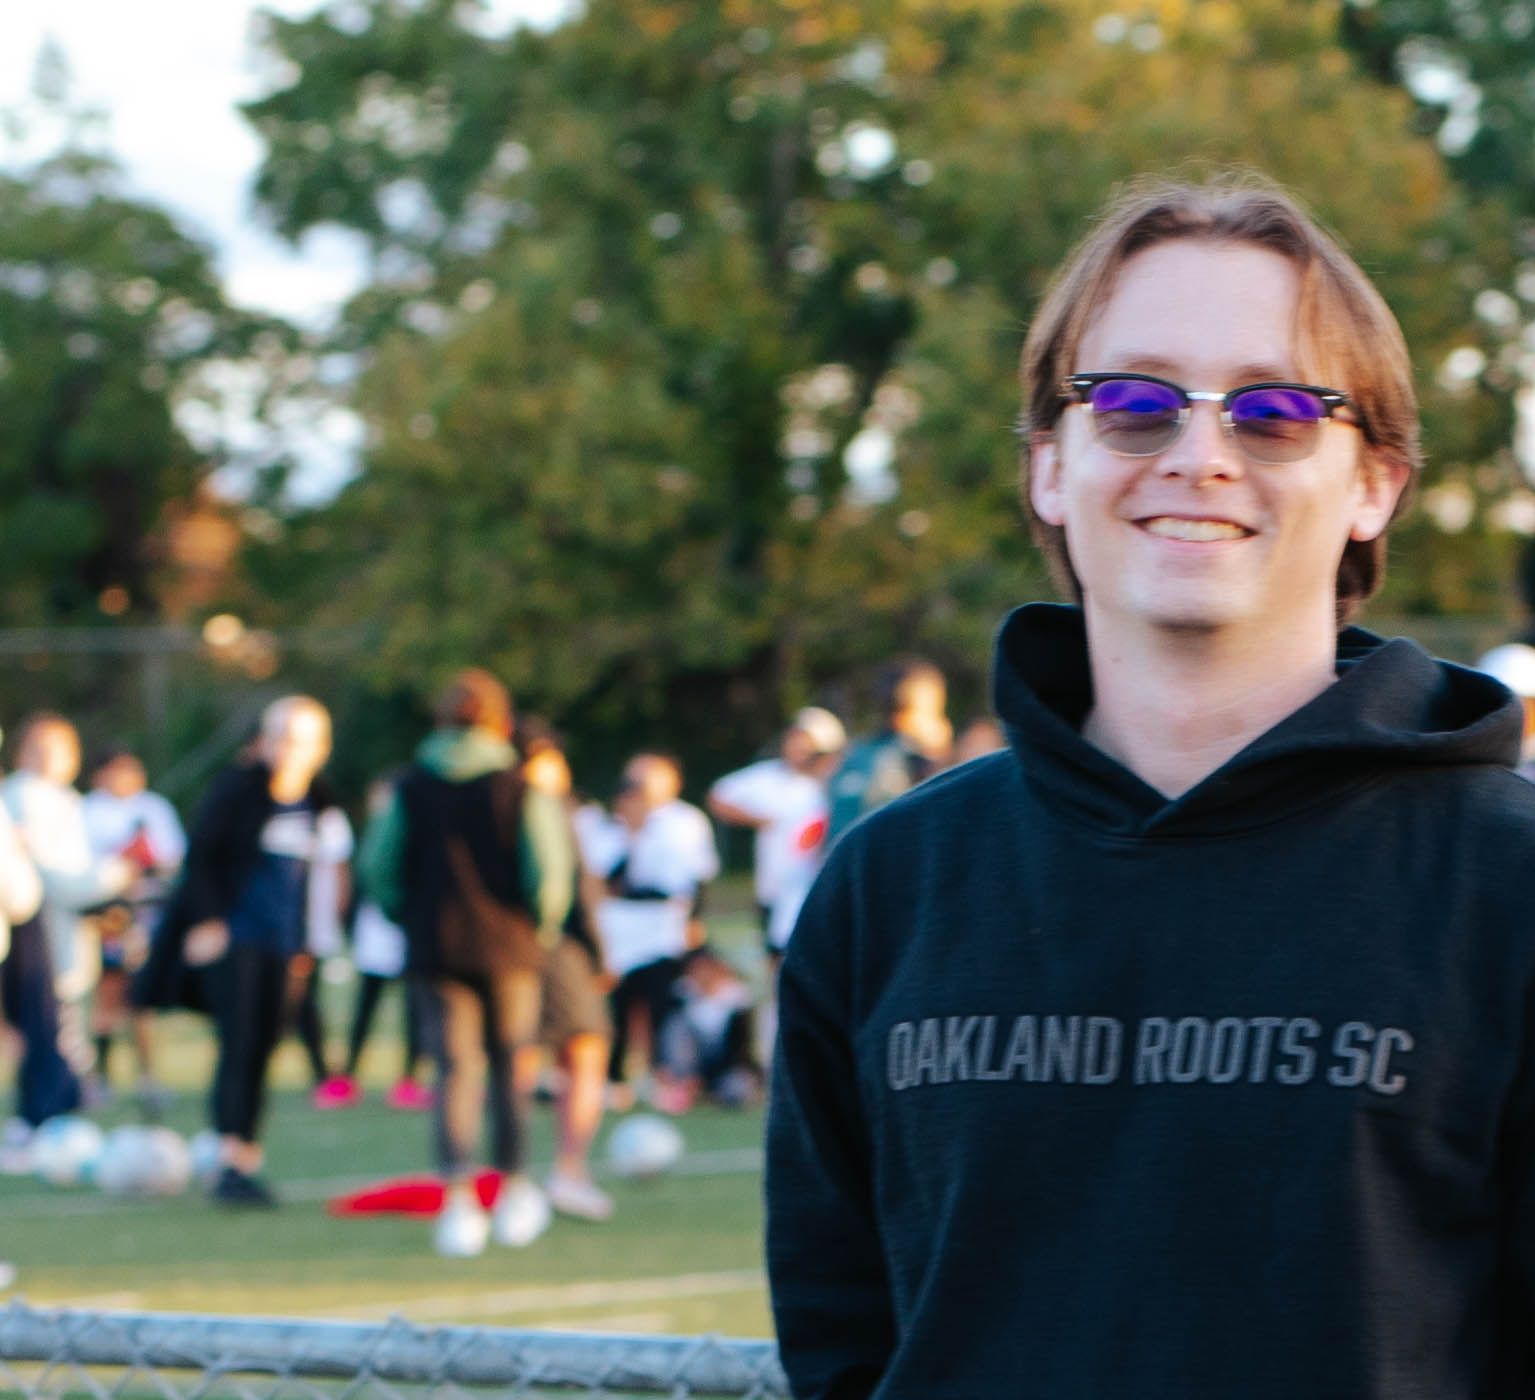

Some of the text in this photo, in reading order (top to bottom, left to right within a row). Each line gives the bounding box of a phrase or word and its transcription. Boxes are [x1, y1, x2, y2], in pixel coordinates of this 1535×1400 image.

[886, 1015, 1415, 1095] OAKLAND ROOTS SC
